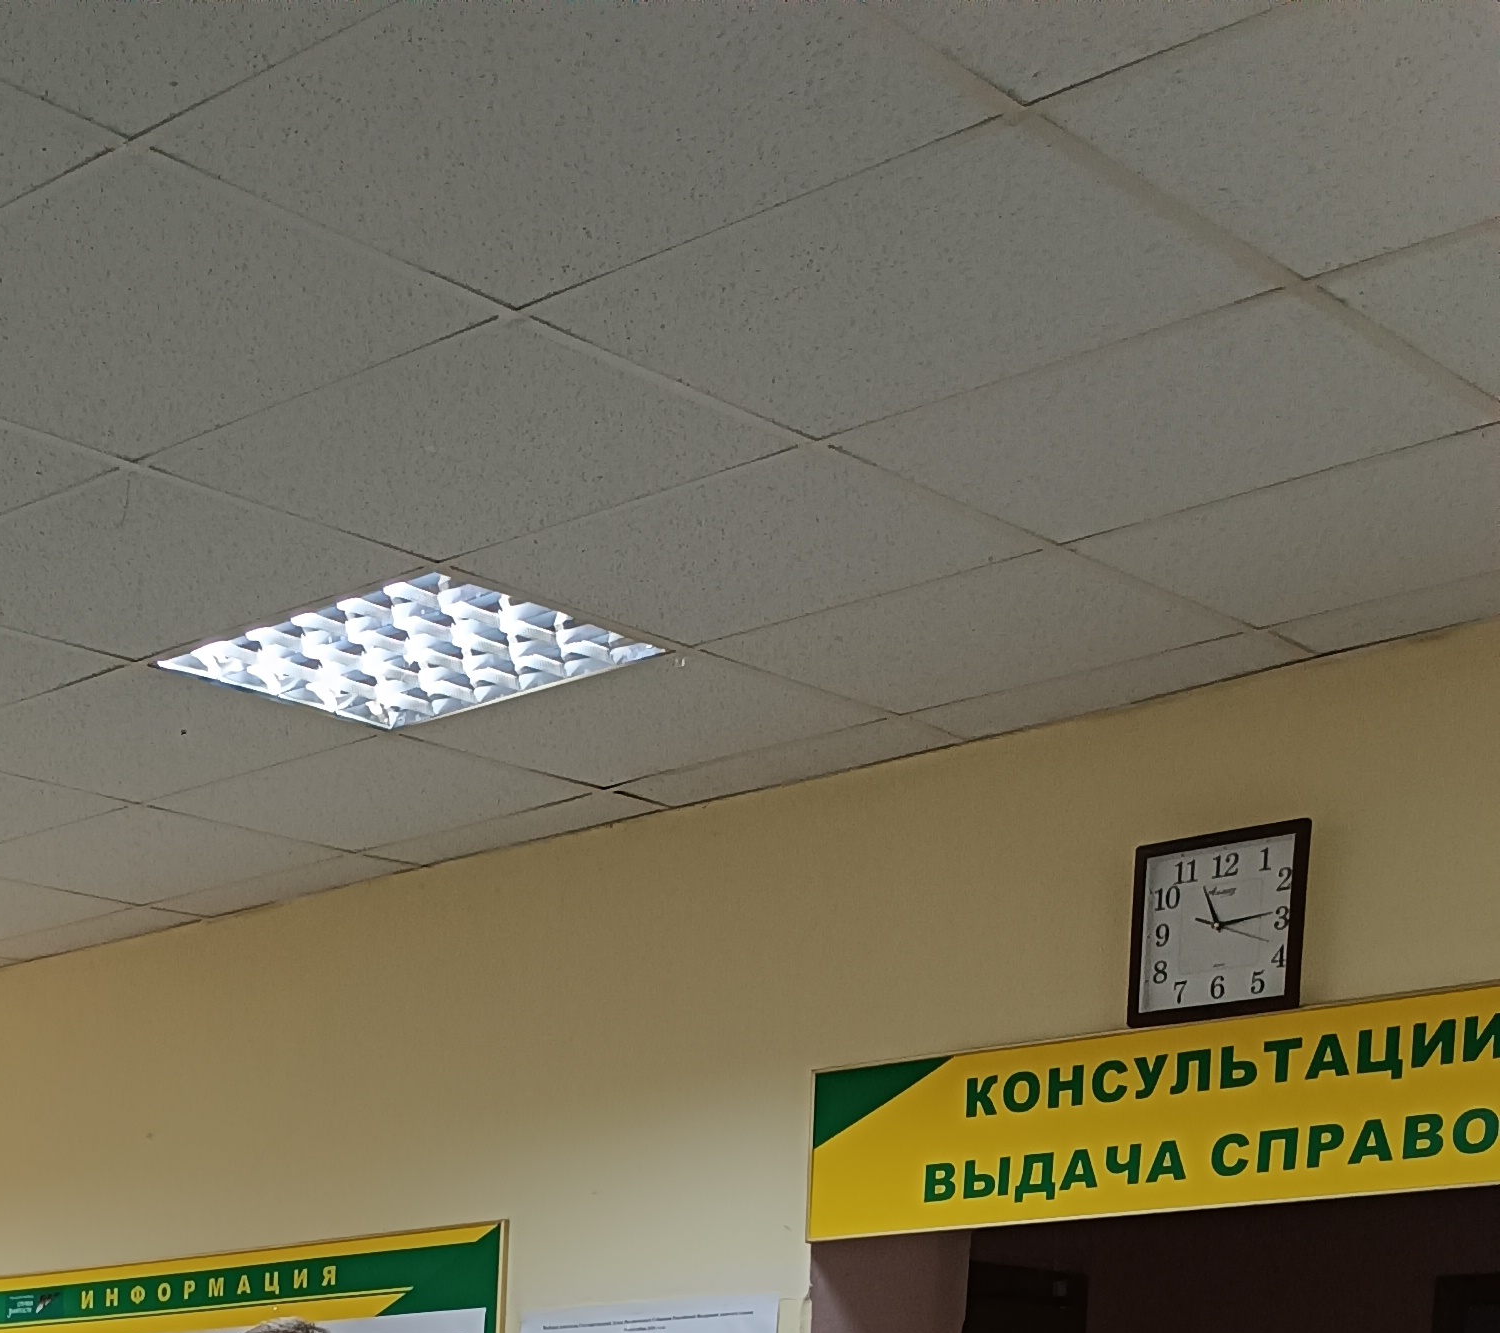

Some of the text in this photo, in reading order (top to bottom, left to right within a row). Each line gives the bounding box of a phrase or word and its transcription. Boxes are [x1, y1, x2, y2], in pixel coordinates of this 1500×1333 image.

[1174, 859, 1198, 885] 11
[1211, 852, 1239, 879] 12
[1258, 847, 1271, 872] 1
[1276, 867, 1292, 892] 2
[1154, 885, 1181, 912] 10
[1274, 905, 1290, 931] 3
[1155, 923, 1170, 947] 9
[1270, 944, 1286, 968] 4
[1152, 960, 1168, 984] 8
[1251, 969, 1265, 994] 5
[1173, 979, 1188, 1004] 7
[1210, 975, 1225, 1000] 6
[965, 1013, 1500, 1118] КОНСУЛЬТАЦИИ
[923, 1139, 1186, 1203] ВЫДАЧА
[81, 1265, 337, 1310] ИНФОРМАЦИЯ
